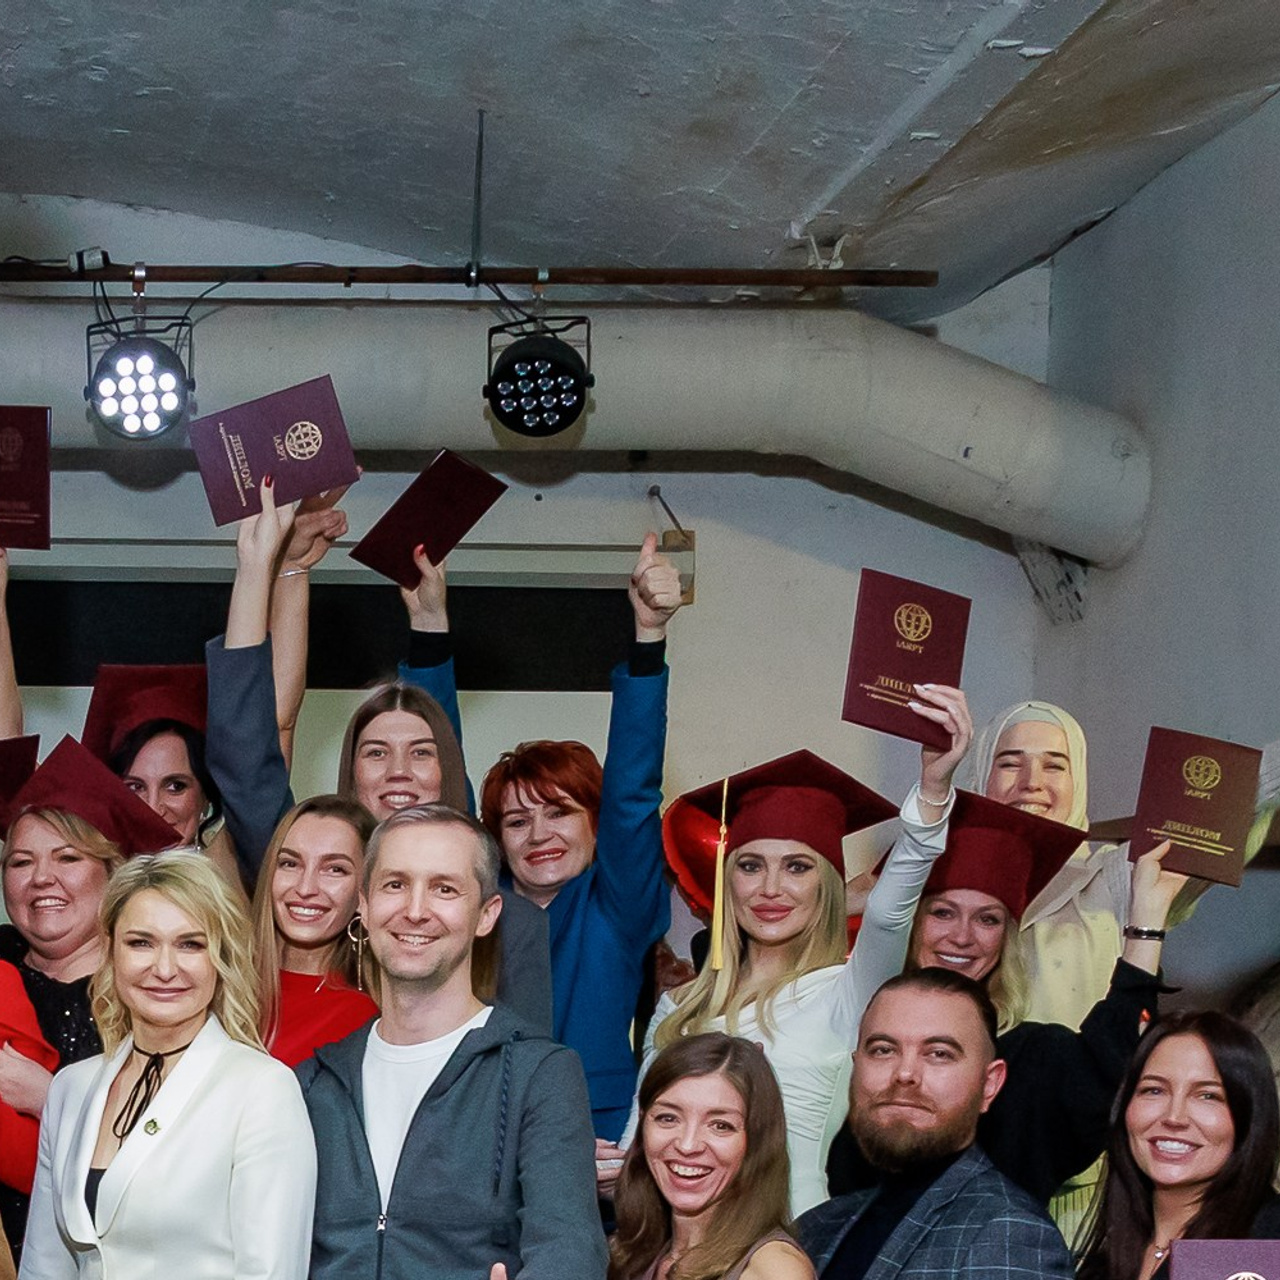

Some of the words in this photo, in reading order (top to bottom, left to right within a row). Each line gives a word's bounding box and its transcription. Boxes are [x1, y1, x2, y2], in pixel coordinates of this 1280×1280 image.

[229, 434, 256, 489] ДИПЛОМ
[875, 675, 916, 693] ДИПЛ
[1161, 819, 1221, 841] ДИПЛОМ
